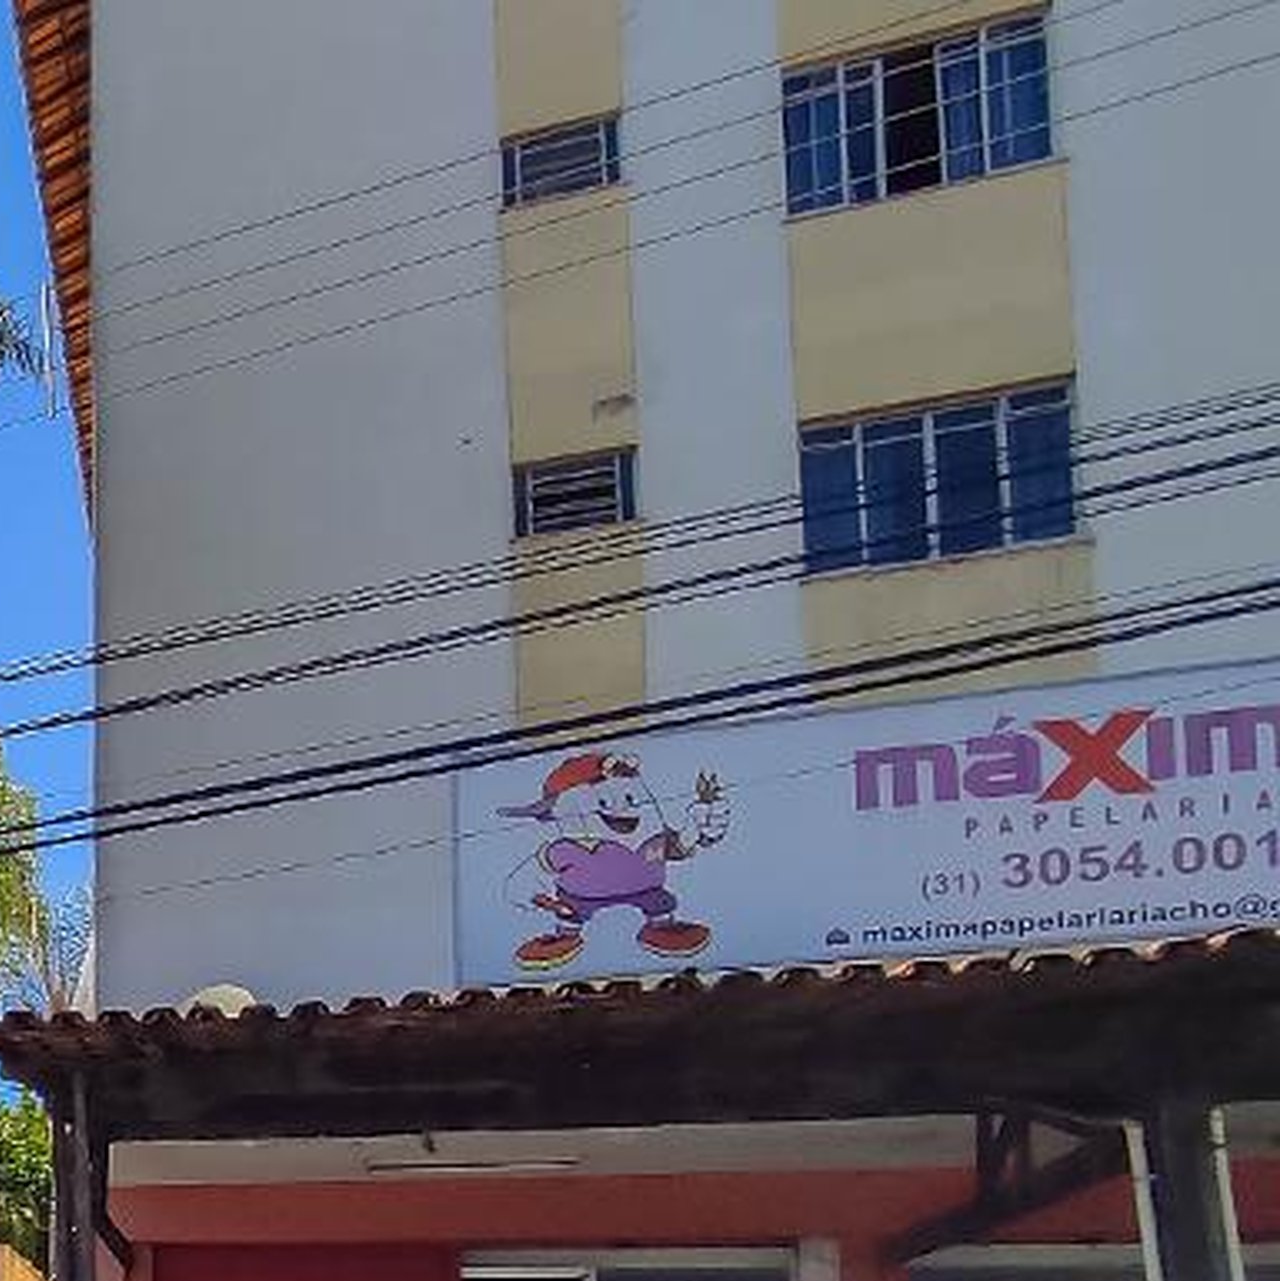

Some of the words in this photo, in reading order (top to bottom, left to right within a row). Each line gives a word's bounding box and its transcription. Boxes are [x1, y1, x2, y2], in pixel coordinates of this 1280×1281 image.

[964, 788, 1273, 838] PAPELARIA
[922, 870, 981, 901] (31)
[1001, 829, 1280, 889] 3054.001
